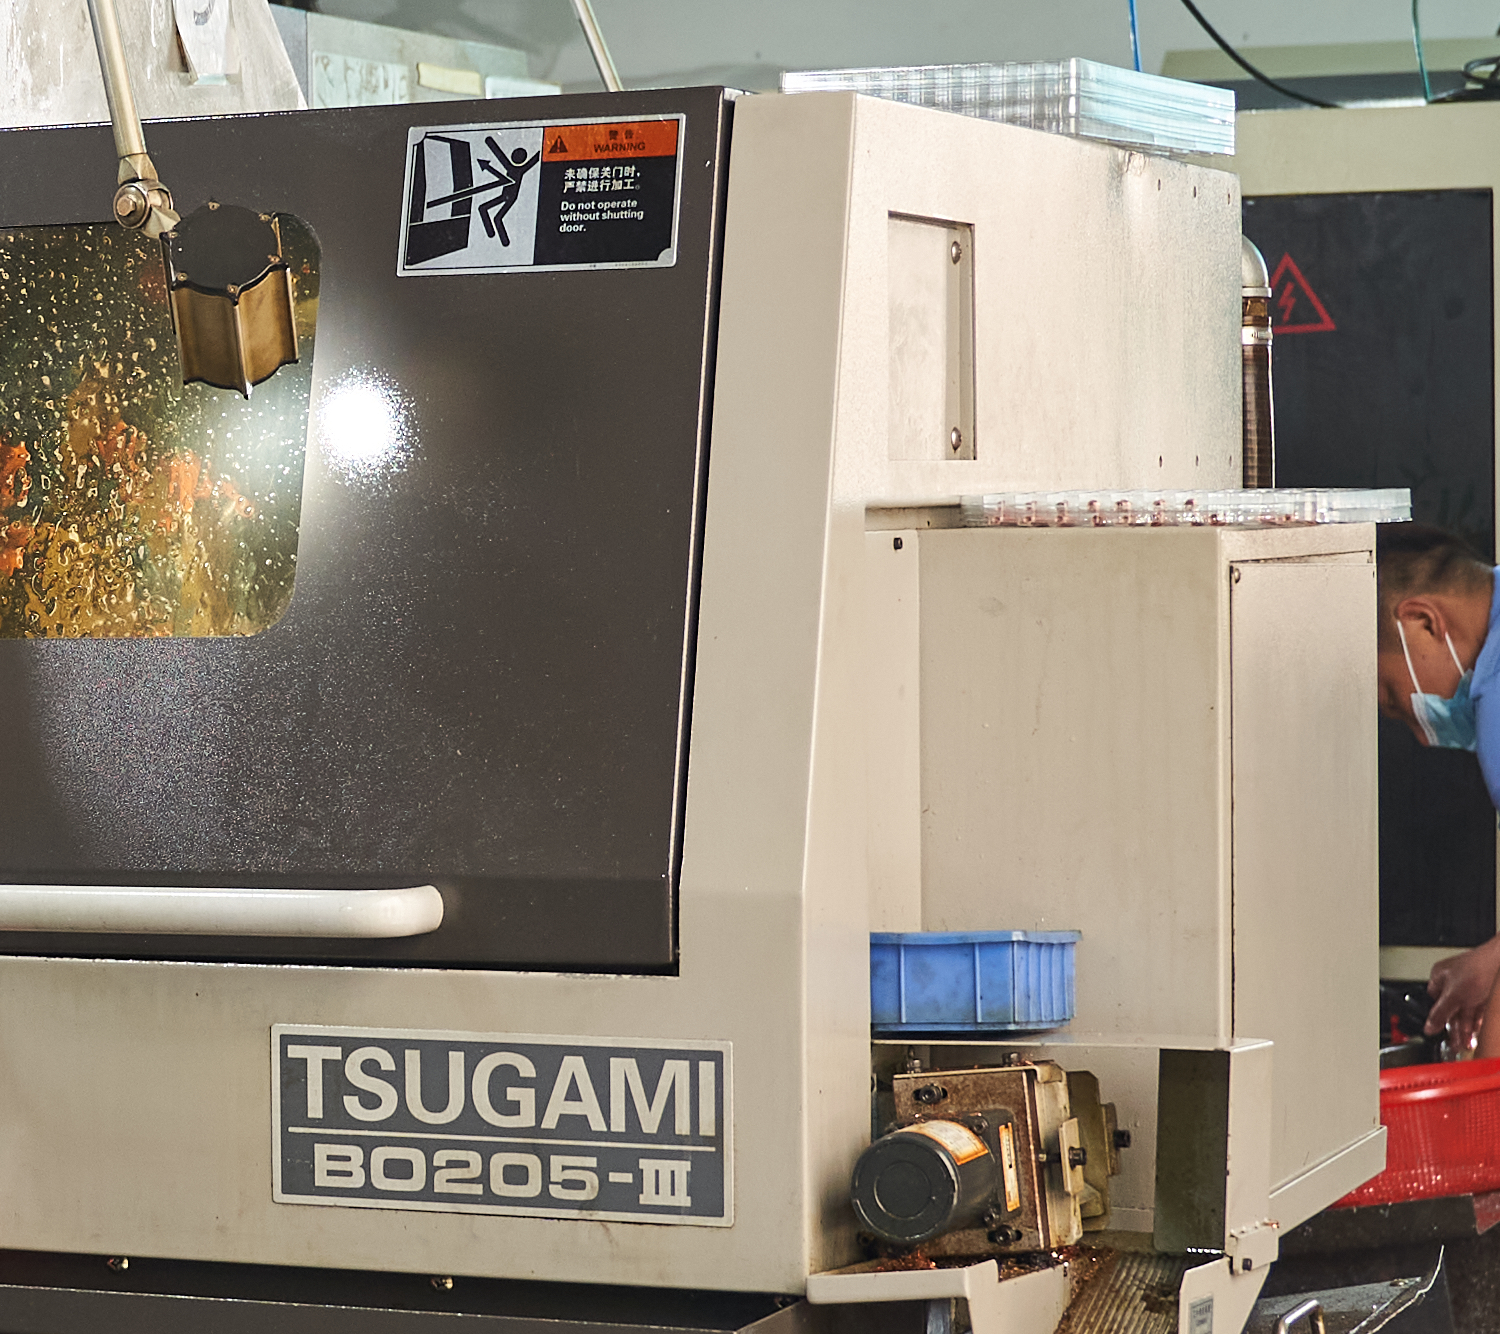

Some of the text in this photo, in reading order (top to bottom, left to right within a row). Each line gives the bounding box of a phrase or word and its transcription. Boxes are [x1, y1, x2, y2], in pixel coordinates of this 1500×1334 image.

[594, 142, 646, 153] WARNING
[561, 199, 638, 211] Do not operate
[560, 209, 644, 222] without shutting
[559, 223, 586, 233] door.
[288, 1044, 716, 1137] TSUGAMI
